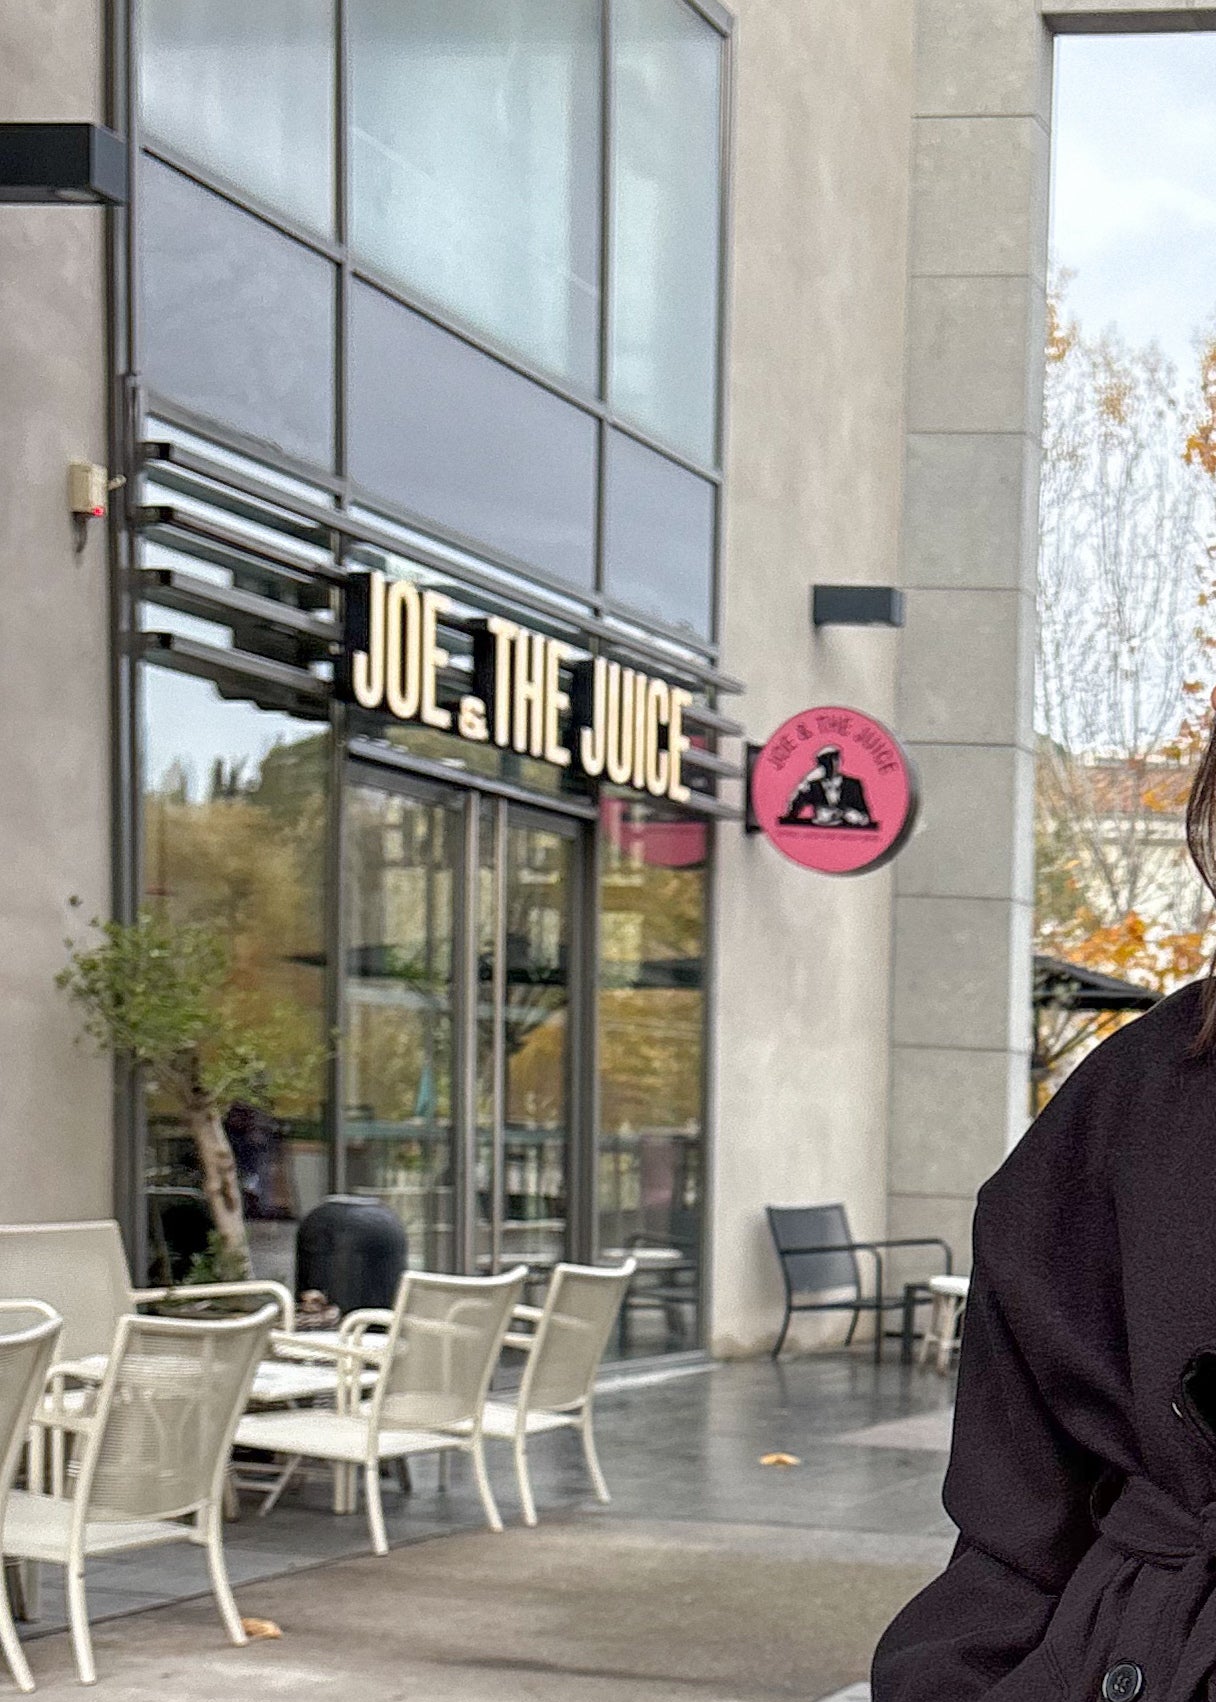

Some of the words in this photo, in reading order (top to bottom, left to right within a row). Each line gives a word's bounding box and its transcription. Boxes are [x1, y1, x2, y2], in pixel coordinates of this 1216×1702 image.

[353, 571, 452, 729] JOE
[458, 695, 489, 741] &
[487, 615, 571, 767] THE
[580, 656, 693, 801] JUICE
[768, 736, 798, 771] JOE
[796, 723, 812, 741] &
[816, 714, 852, 737] THE
[855, 727, 898, 775] JUICE
